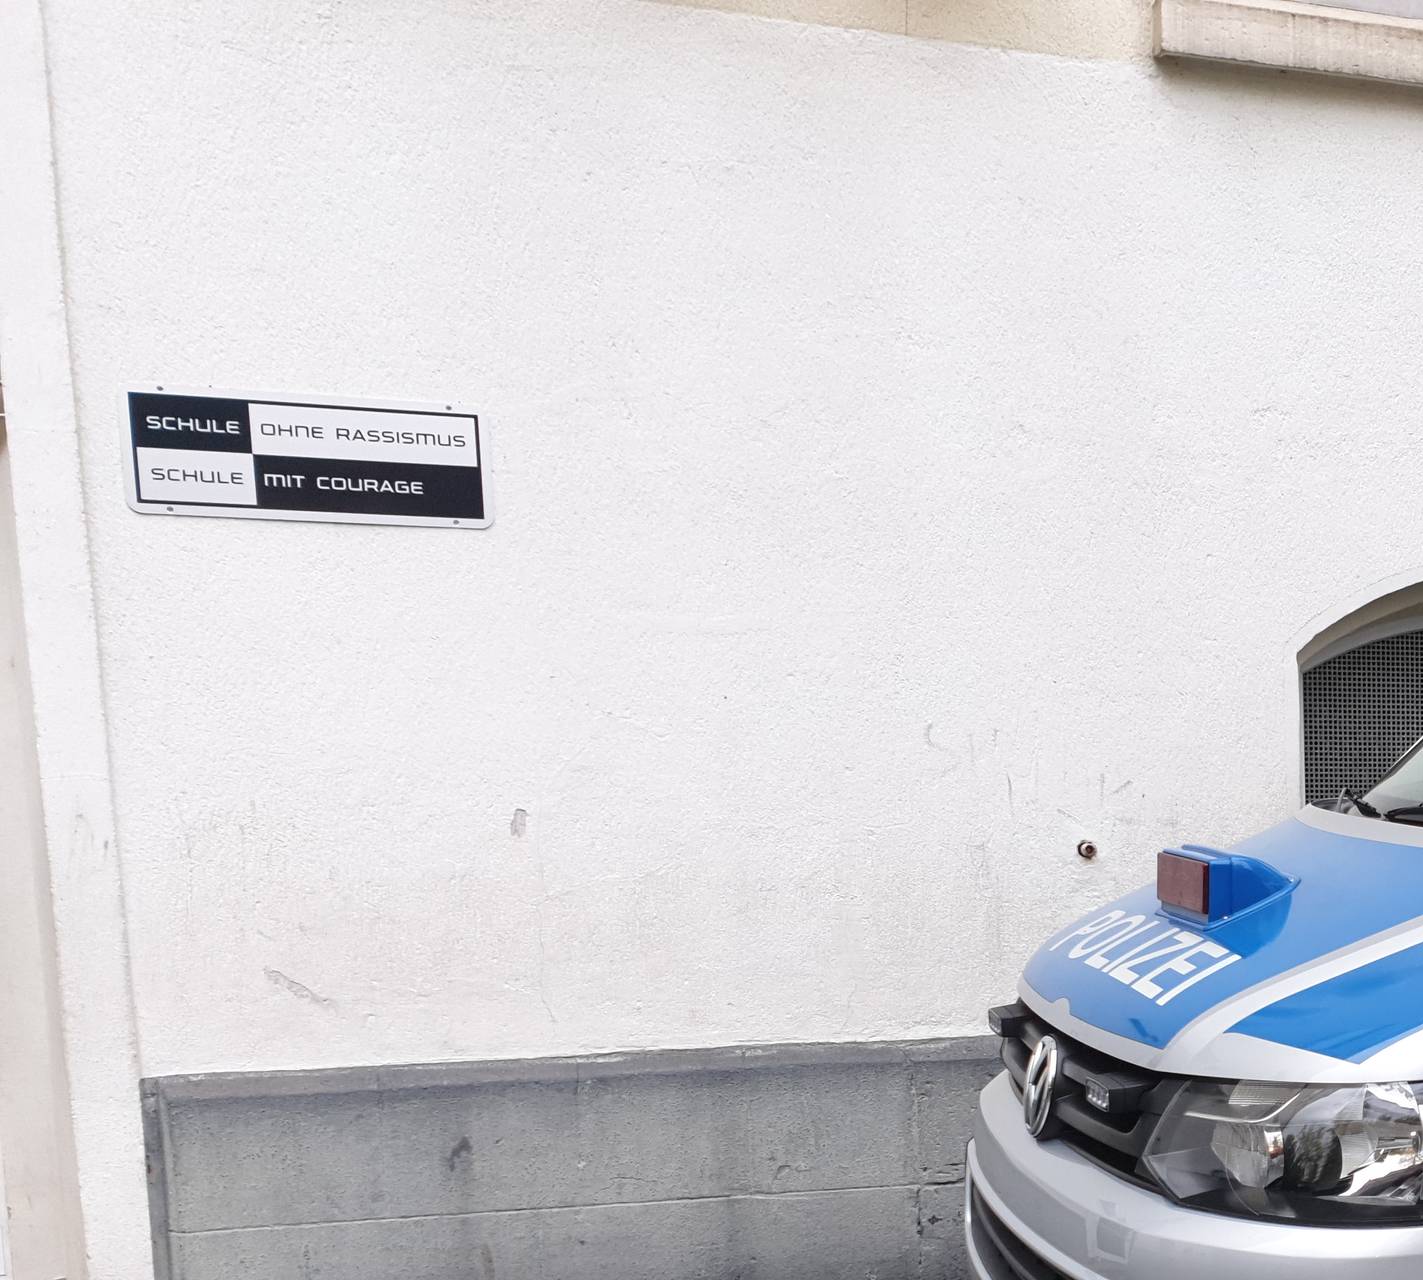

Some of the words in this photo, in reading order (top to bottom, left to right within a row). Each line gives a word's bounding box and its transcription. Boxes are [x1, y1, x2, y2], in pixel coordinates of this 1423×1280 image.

[145, 415, 241, 434] SCHULE
[260, 423, 325, 440] OHNE
[335, 427, 466, 448] RASSISMUS
[151, 467, 244, 485] SCHULE
[263, 473, 305, 489] MIT
[316, 476, 424, 495] COURAGE
[1050, 910, 1242, 1006] POLIZEI
